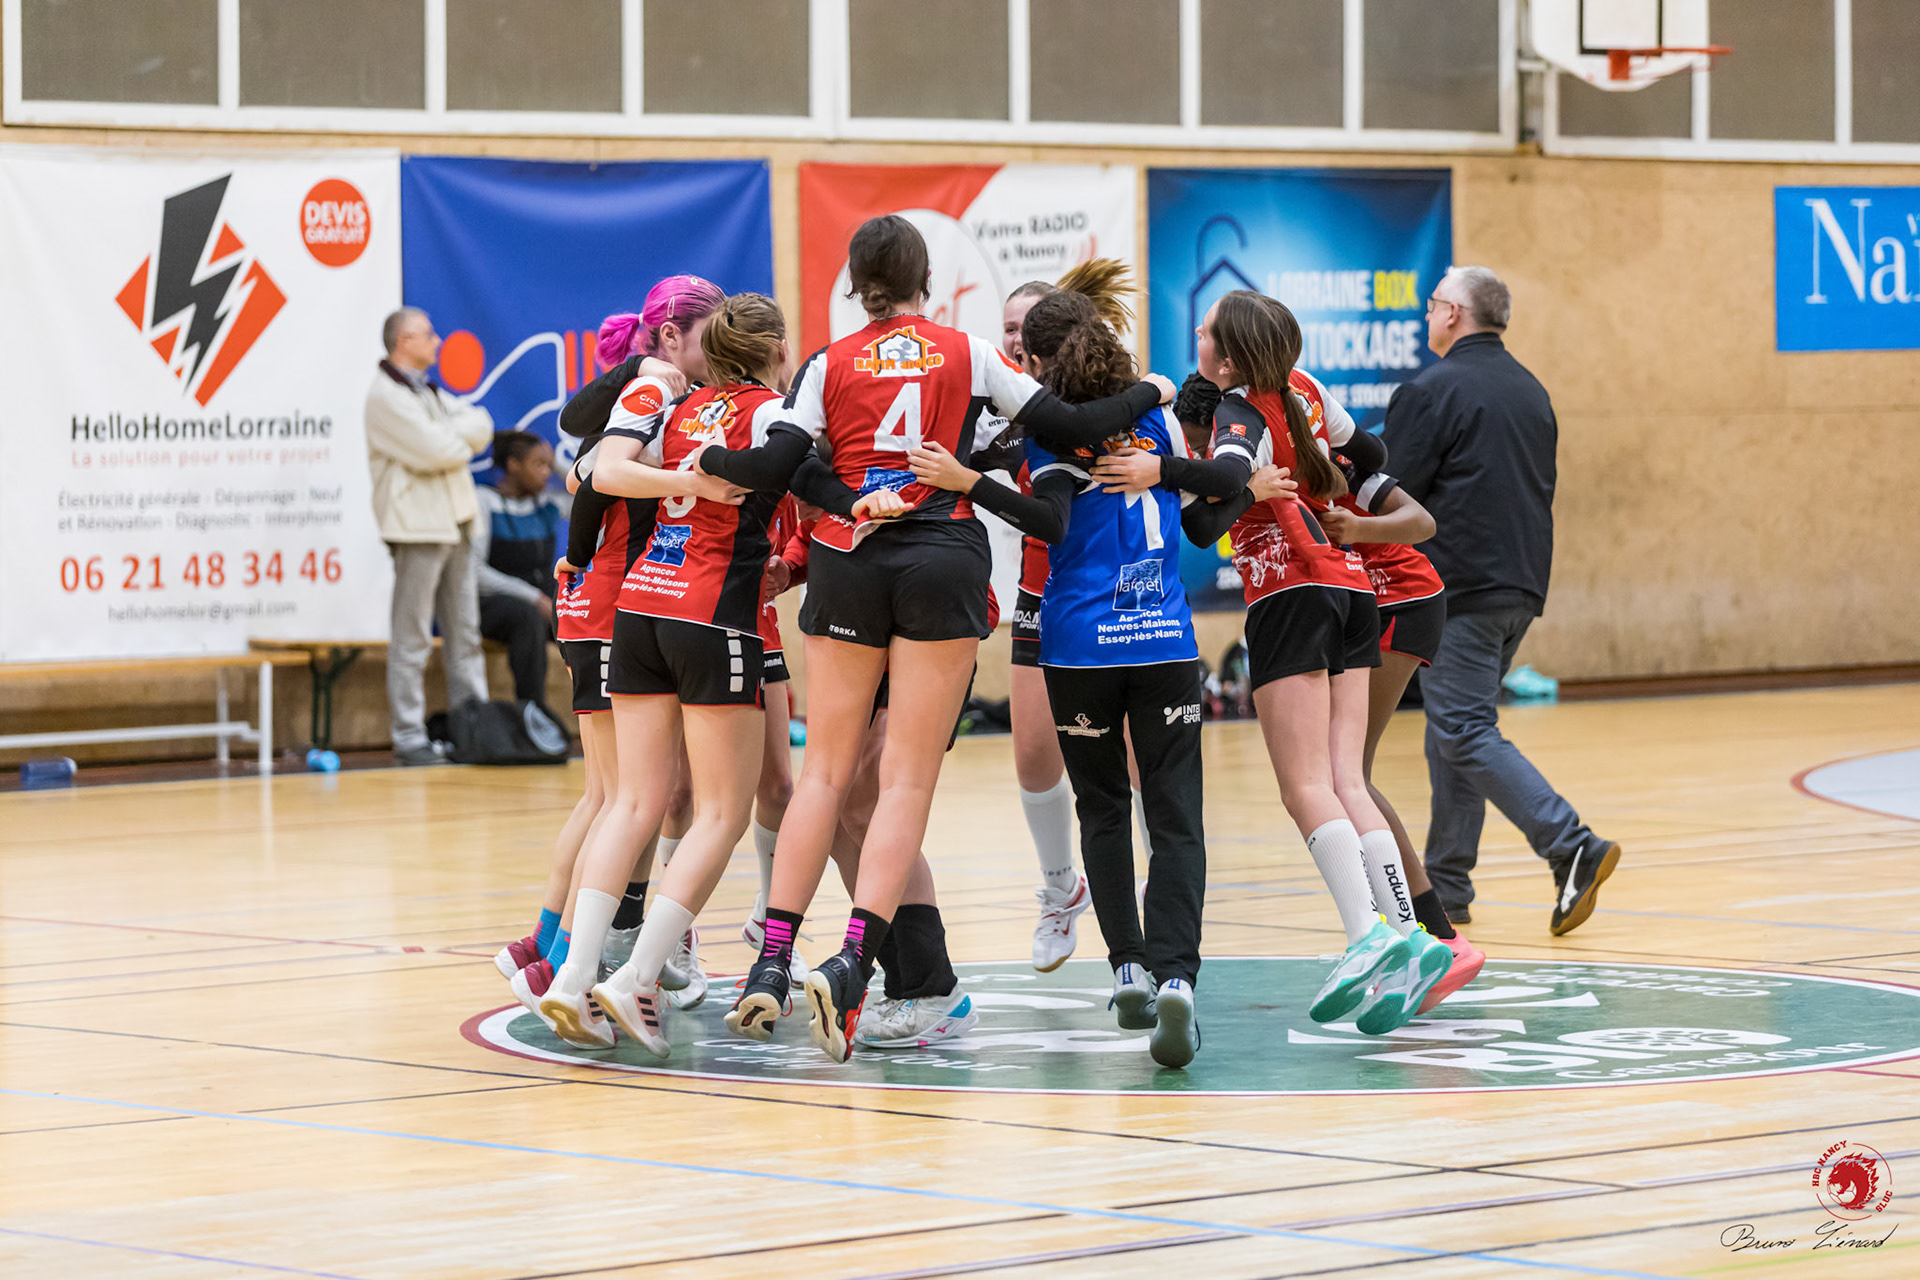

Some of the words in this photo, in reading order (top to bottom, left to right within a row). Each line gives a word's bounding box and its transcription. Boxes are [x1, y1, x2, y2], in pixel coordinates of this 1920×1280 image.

[305, 200, 367, 226] DEVIS
[1029, 211, 1088, 235] RADIO
[305, 225, 365, 245] GRATUIT
[1014, 242, 1068, 264] Nancy
[1803, 198, 1920, 304] Na
[1267, 269, 1372, 312] LORRAINE
[1374, 269, 1420, 311] BOX
[70, 409, 334, 442] HelloHomeLorraine
[874, 381, 925, 452] 4
[988, 417, 1008, 427] erim
[71, 450, 91, 468] La
[99, 448, 172, 468] solution
[178, 449, 219, 468] pour
[226, 446, 272, 464] votre
[60, 555, 105, 593] 06
[121, 554, 166, 591] 21
[182, 550, 226, 589] 48
[242, 548, 284, 587] 34
[298, 547, 343, 585] 46
[640, 563, 677, 577] Agences
[1097, 619, 1181, 634] Neuves-Maisons
[1097, 630, 1184, 645] Essey-lès-Nancy
[1383, 863, 1415, 923] Kempa
[1555, 1042, 1887, 1079] Carrefour
